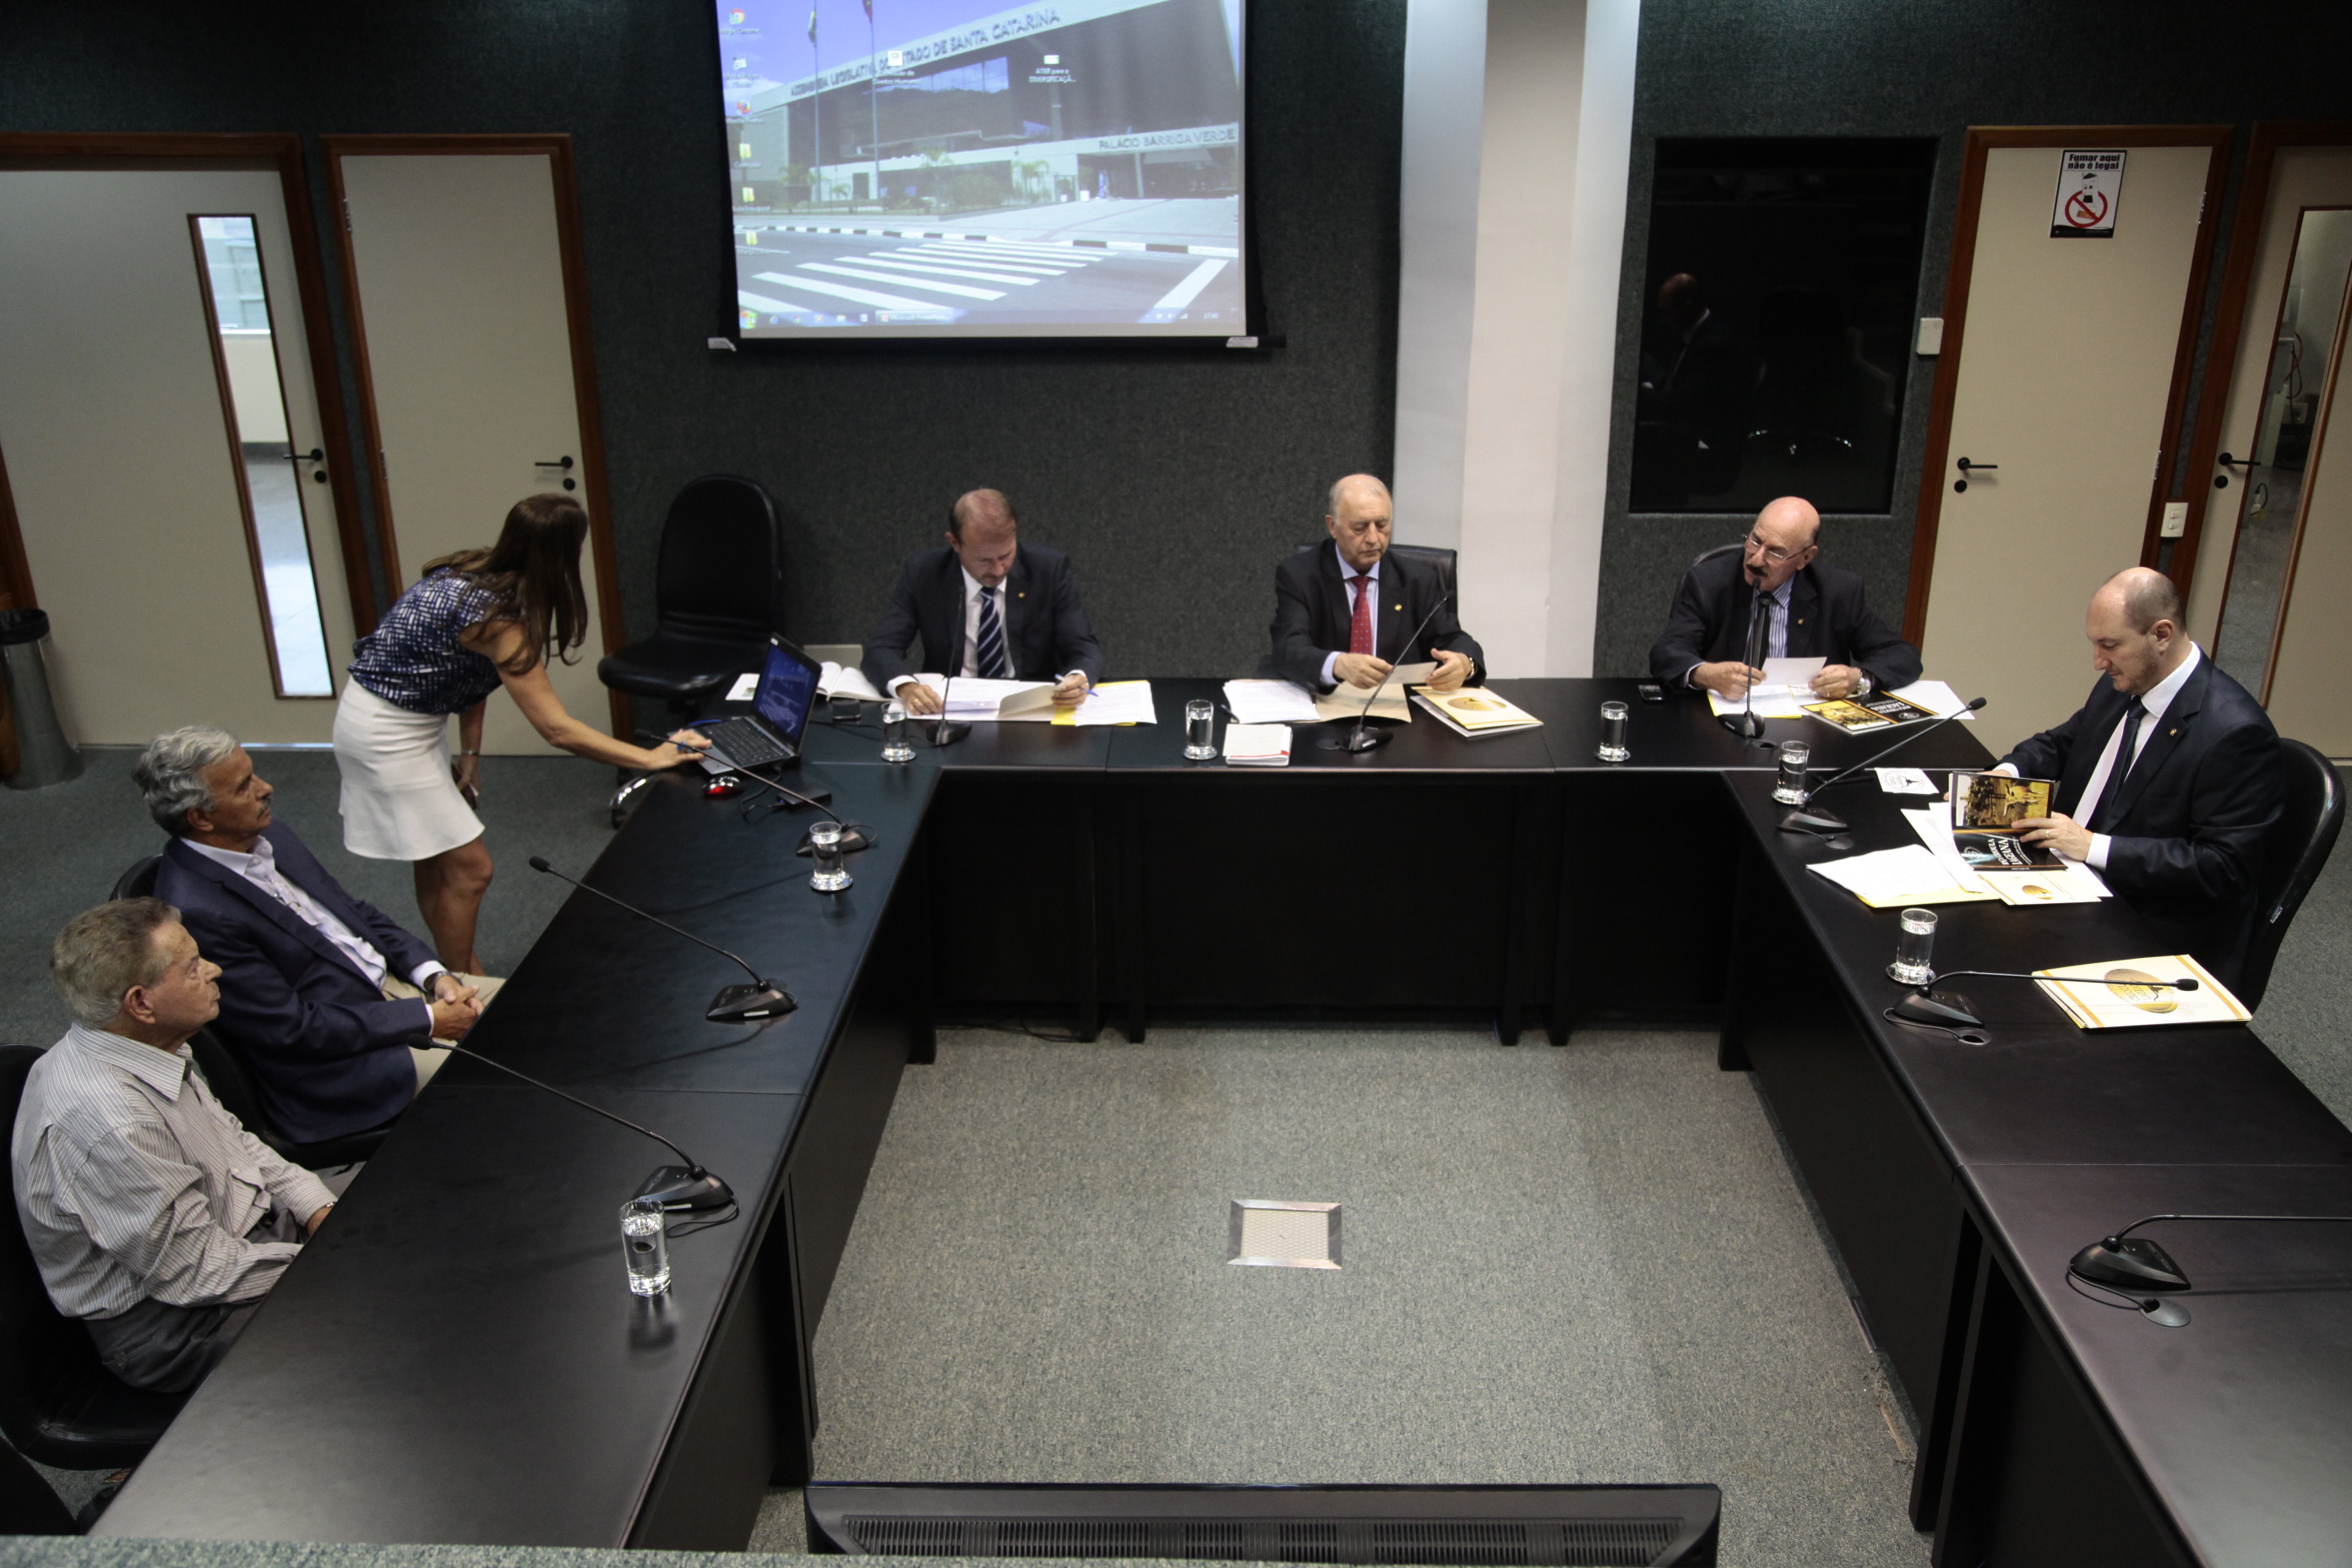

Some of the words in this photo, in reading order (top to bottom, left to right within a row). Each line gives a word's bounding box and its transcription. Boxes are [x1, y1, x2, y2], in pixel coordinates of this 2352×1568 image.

[933, 39, 948, 57] DE
[950, 29, 988, 52] SANTA
[992, 9, 1061, 39] CATARINA
[1144, 133, 1192, 147] BARRIGA
[1193, 128, 1235, 142] VERDE
[2069, 154, 2098, 162] Fumar
[2099, 154, 2121, 163] aqui
[2067, 161, 2085, 170] não
[2088, 161, 2093, 170] é
[2095, 161, 2119, 171] legal
